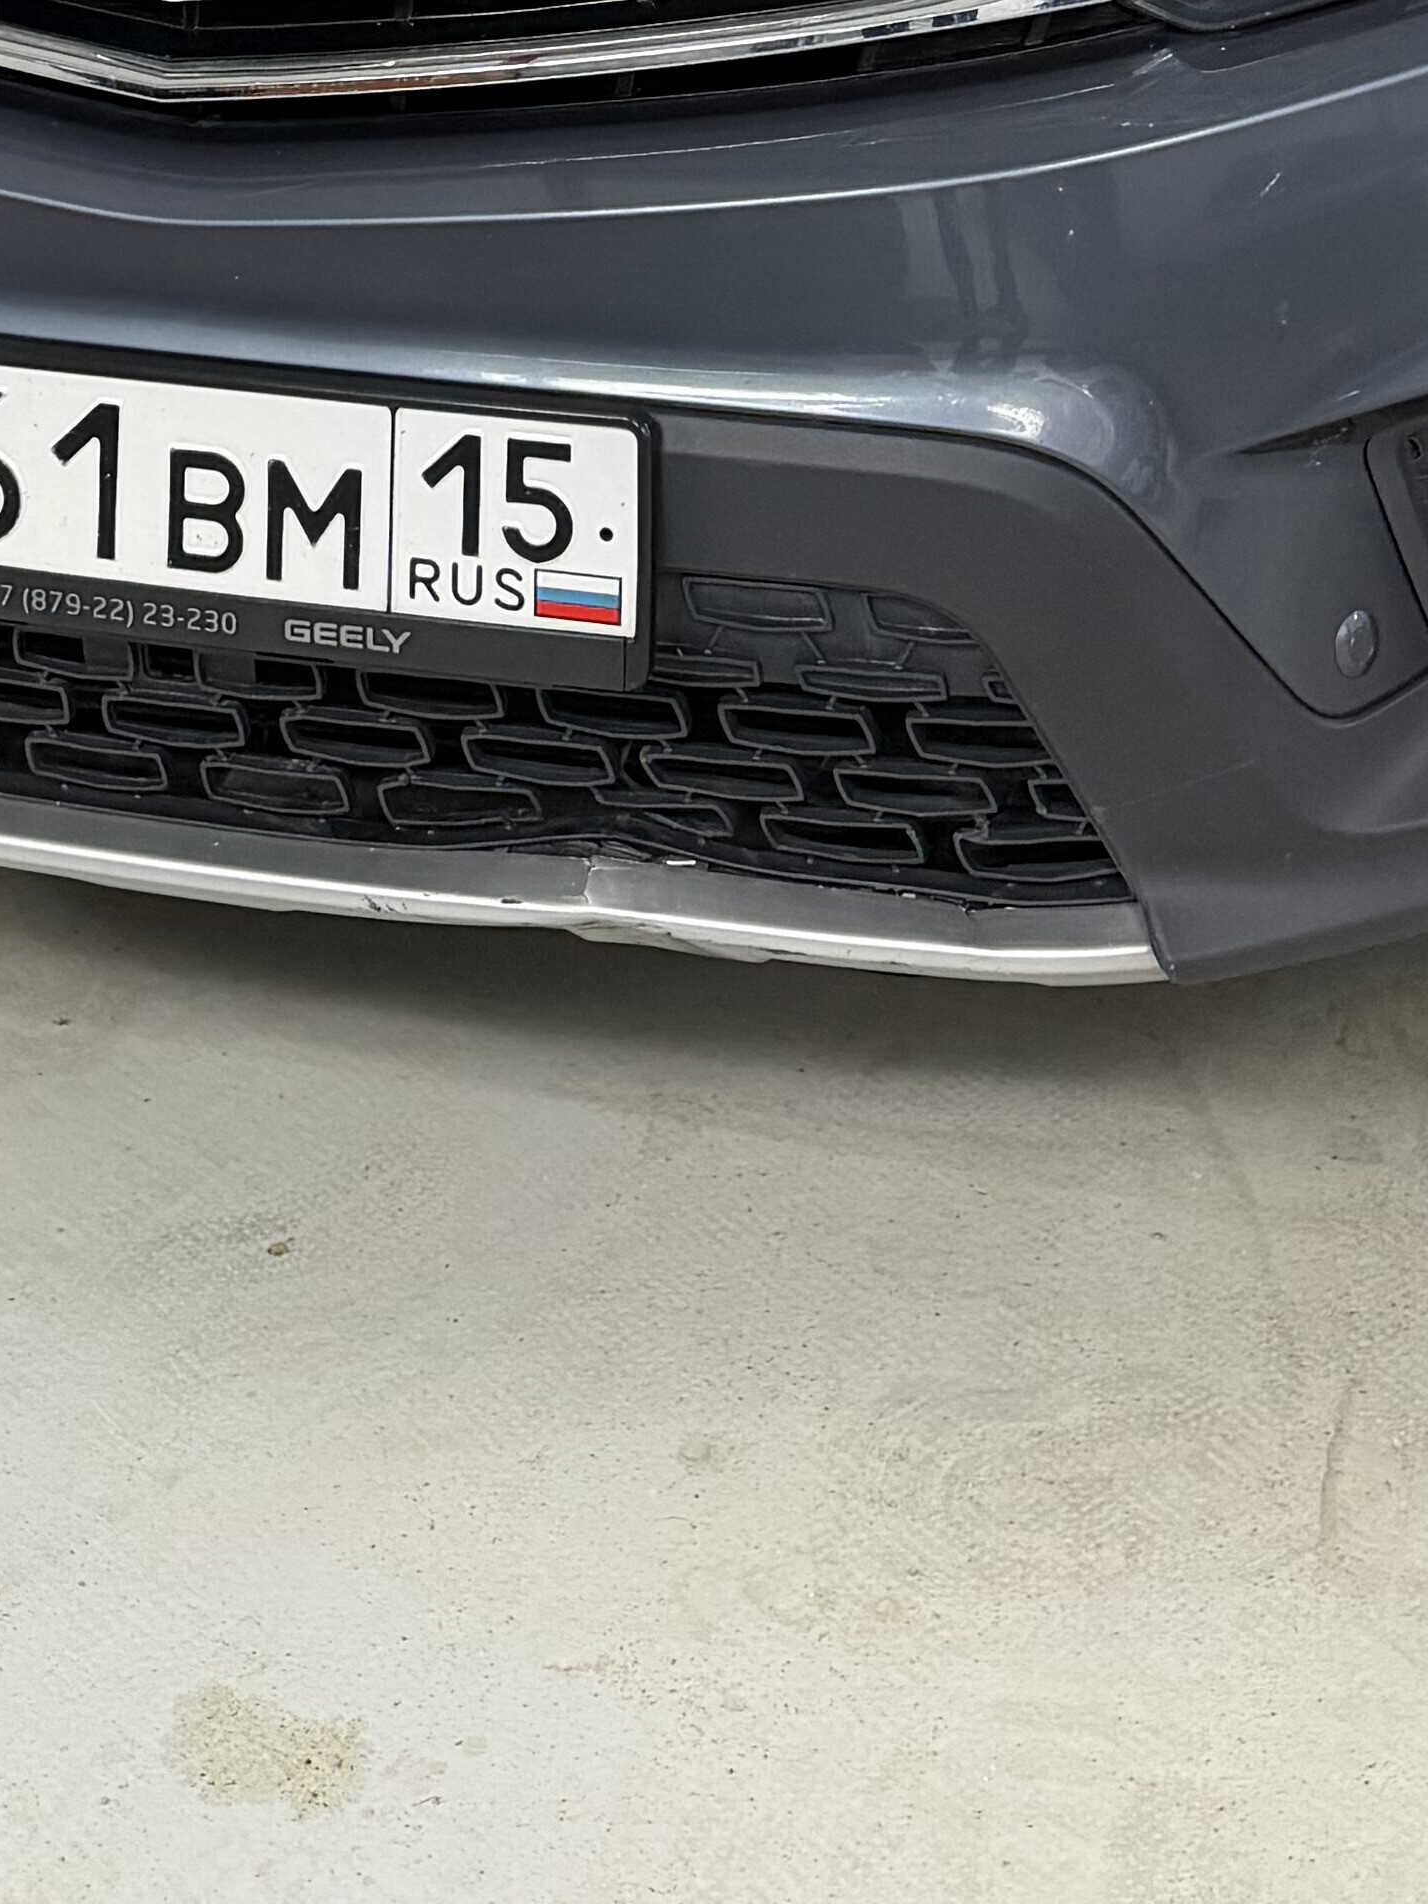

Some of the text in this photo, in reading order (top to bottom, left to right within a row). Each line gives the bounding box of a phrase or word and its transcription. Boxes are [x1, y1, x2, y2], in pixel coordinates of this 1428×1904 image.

[421, 433, 574, 564] 15
[409, 556, 526, 612] RUS
[21, 587, 135, 629] (879-22)
[142, 601, 238, 636] 23-230
[284, 618, 412, 655] GEELY
